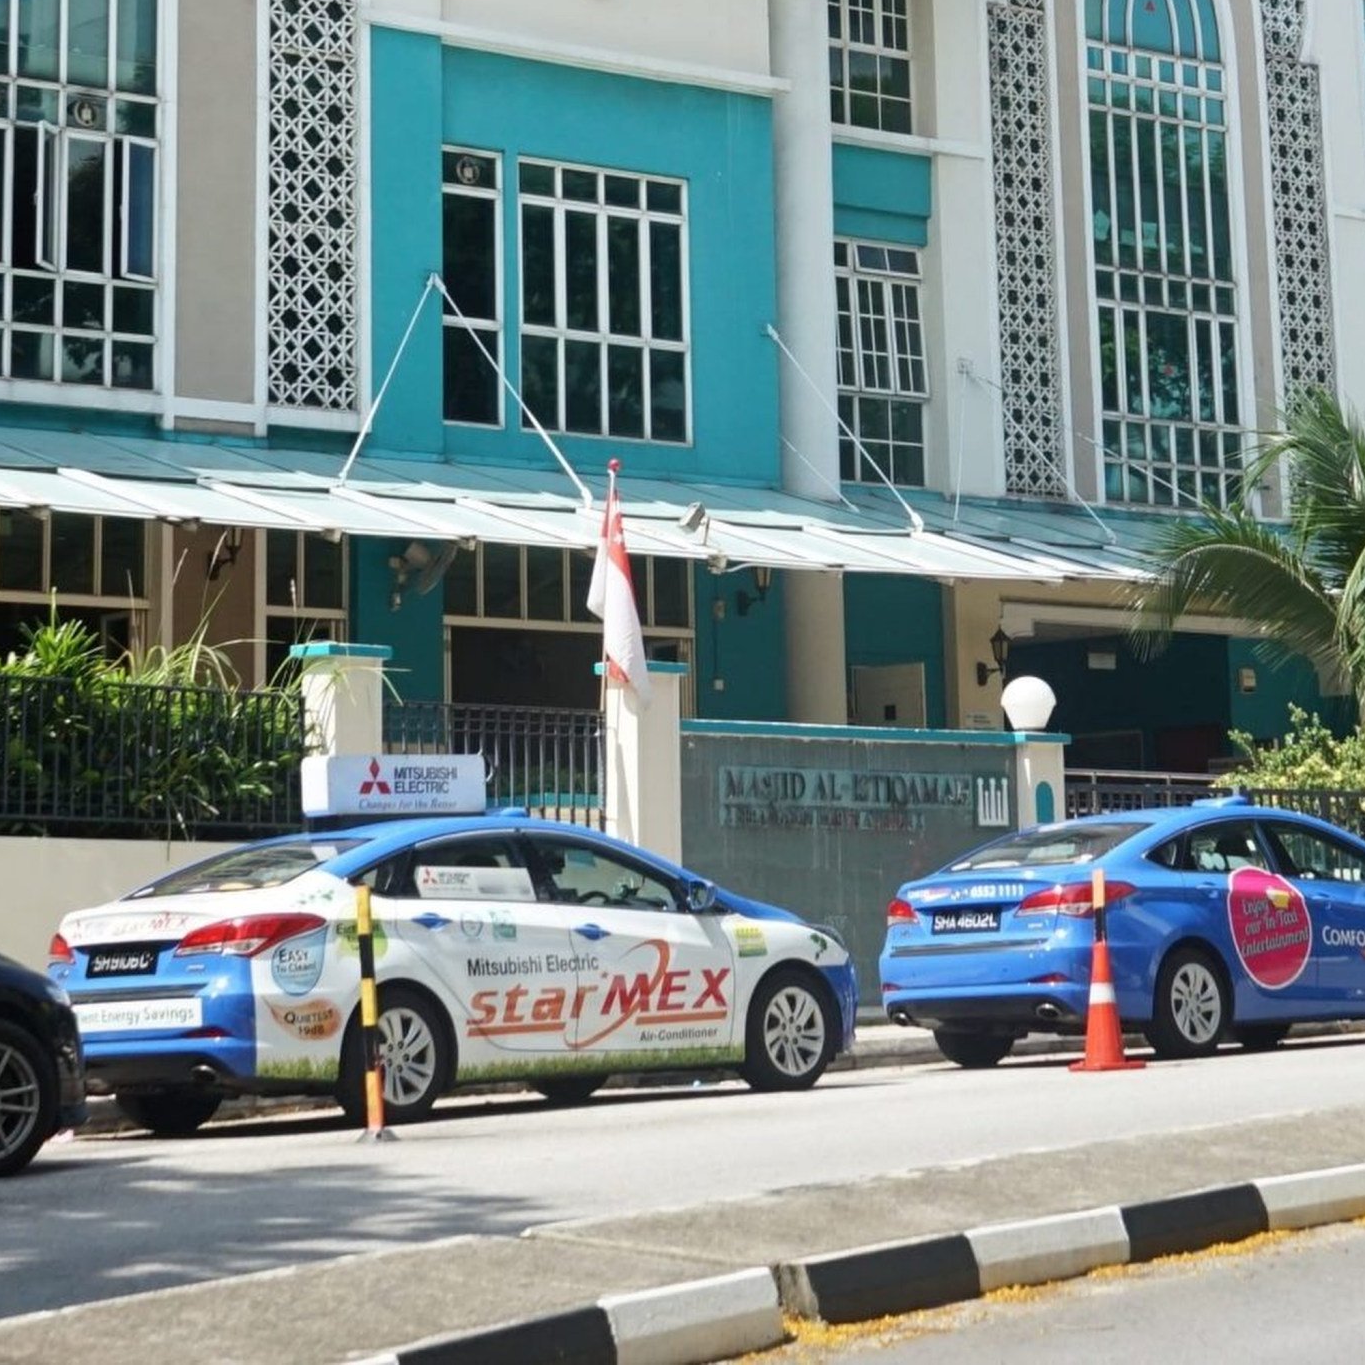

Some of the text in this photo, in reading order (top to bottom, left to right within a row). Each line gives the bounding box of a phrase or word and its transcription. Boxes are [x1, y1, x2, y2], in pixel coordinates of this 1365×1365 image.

[393, 766, 458, 780] MITSUBISHI
[393, 781, 450, 795] ELECTRIC
[724, 769, 806, 801] MASJID
[1242, 897, 1270, 918] Enjoy
[1245, 921, 1262, 936] our
[1241, 927, 1310, 958] Entertainment
[467, 953, 600, 978] Mitsubishi Electric
[101, 1009, 141, 1026] Energy
[143, 1005, 195, 1023] Savings
[638, 1026, 718, 1043] Air-Conditioner
